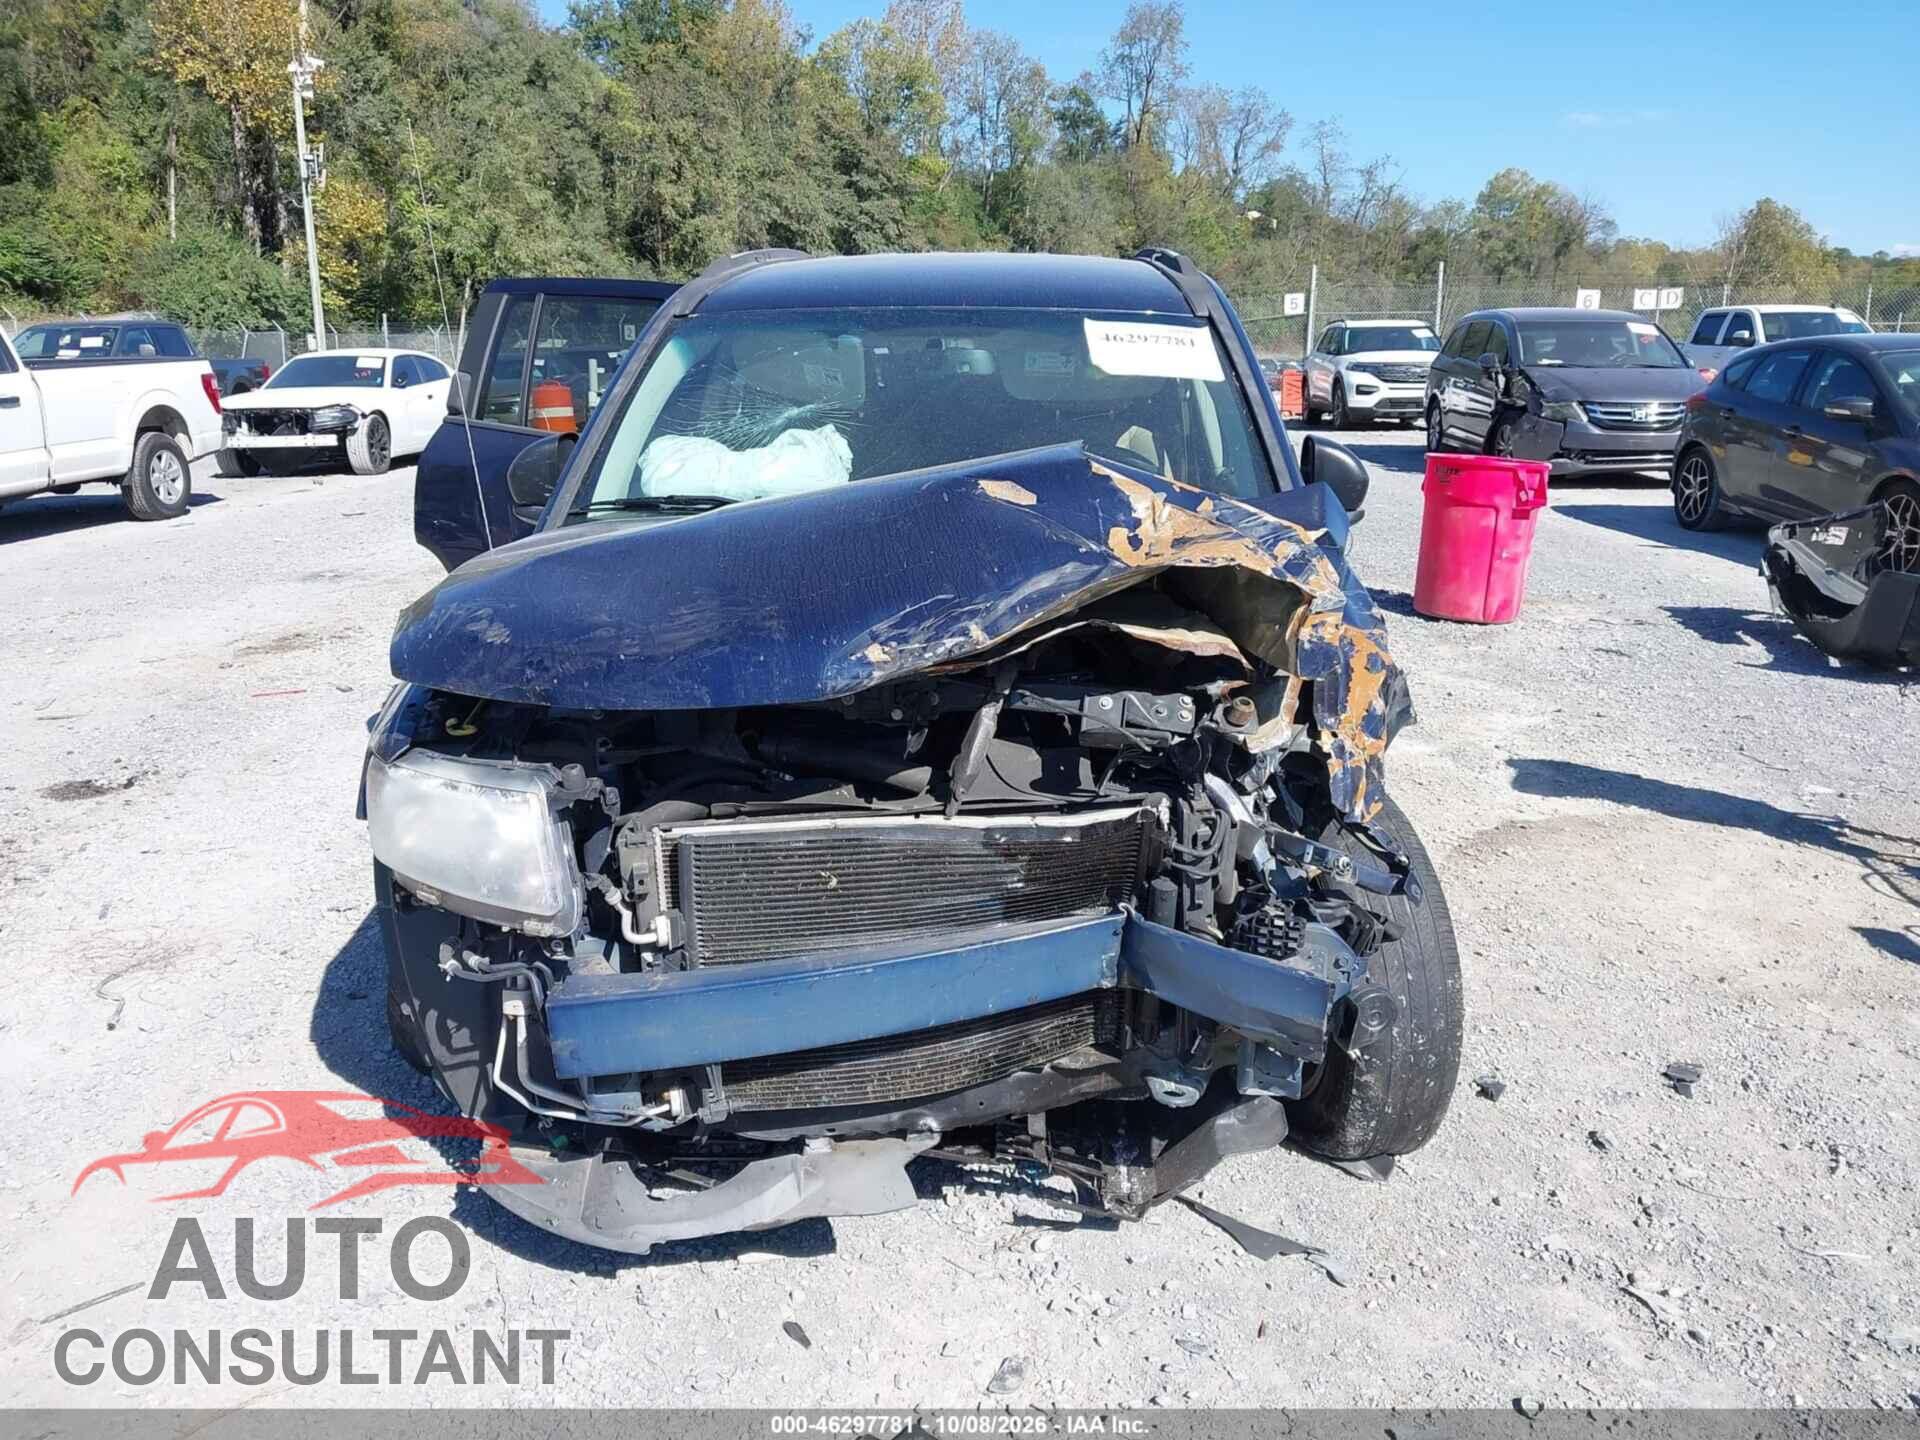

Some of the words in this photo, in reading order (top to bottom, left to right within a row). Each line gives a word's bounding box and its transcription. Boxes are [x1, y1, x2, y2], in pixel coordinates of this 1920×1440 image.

[1289, 297, 1298, 310] 5
[1583, 294, 1593, 308] 6
[1640, 291, 1652, 306] C
[1666, 291, 1679, 305] D
[1099, 333, 1196, 348] 46297781
